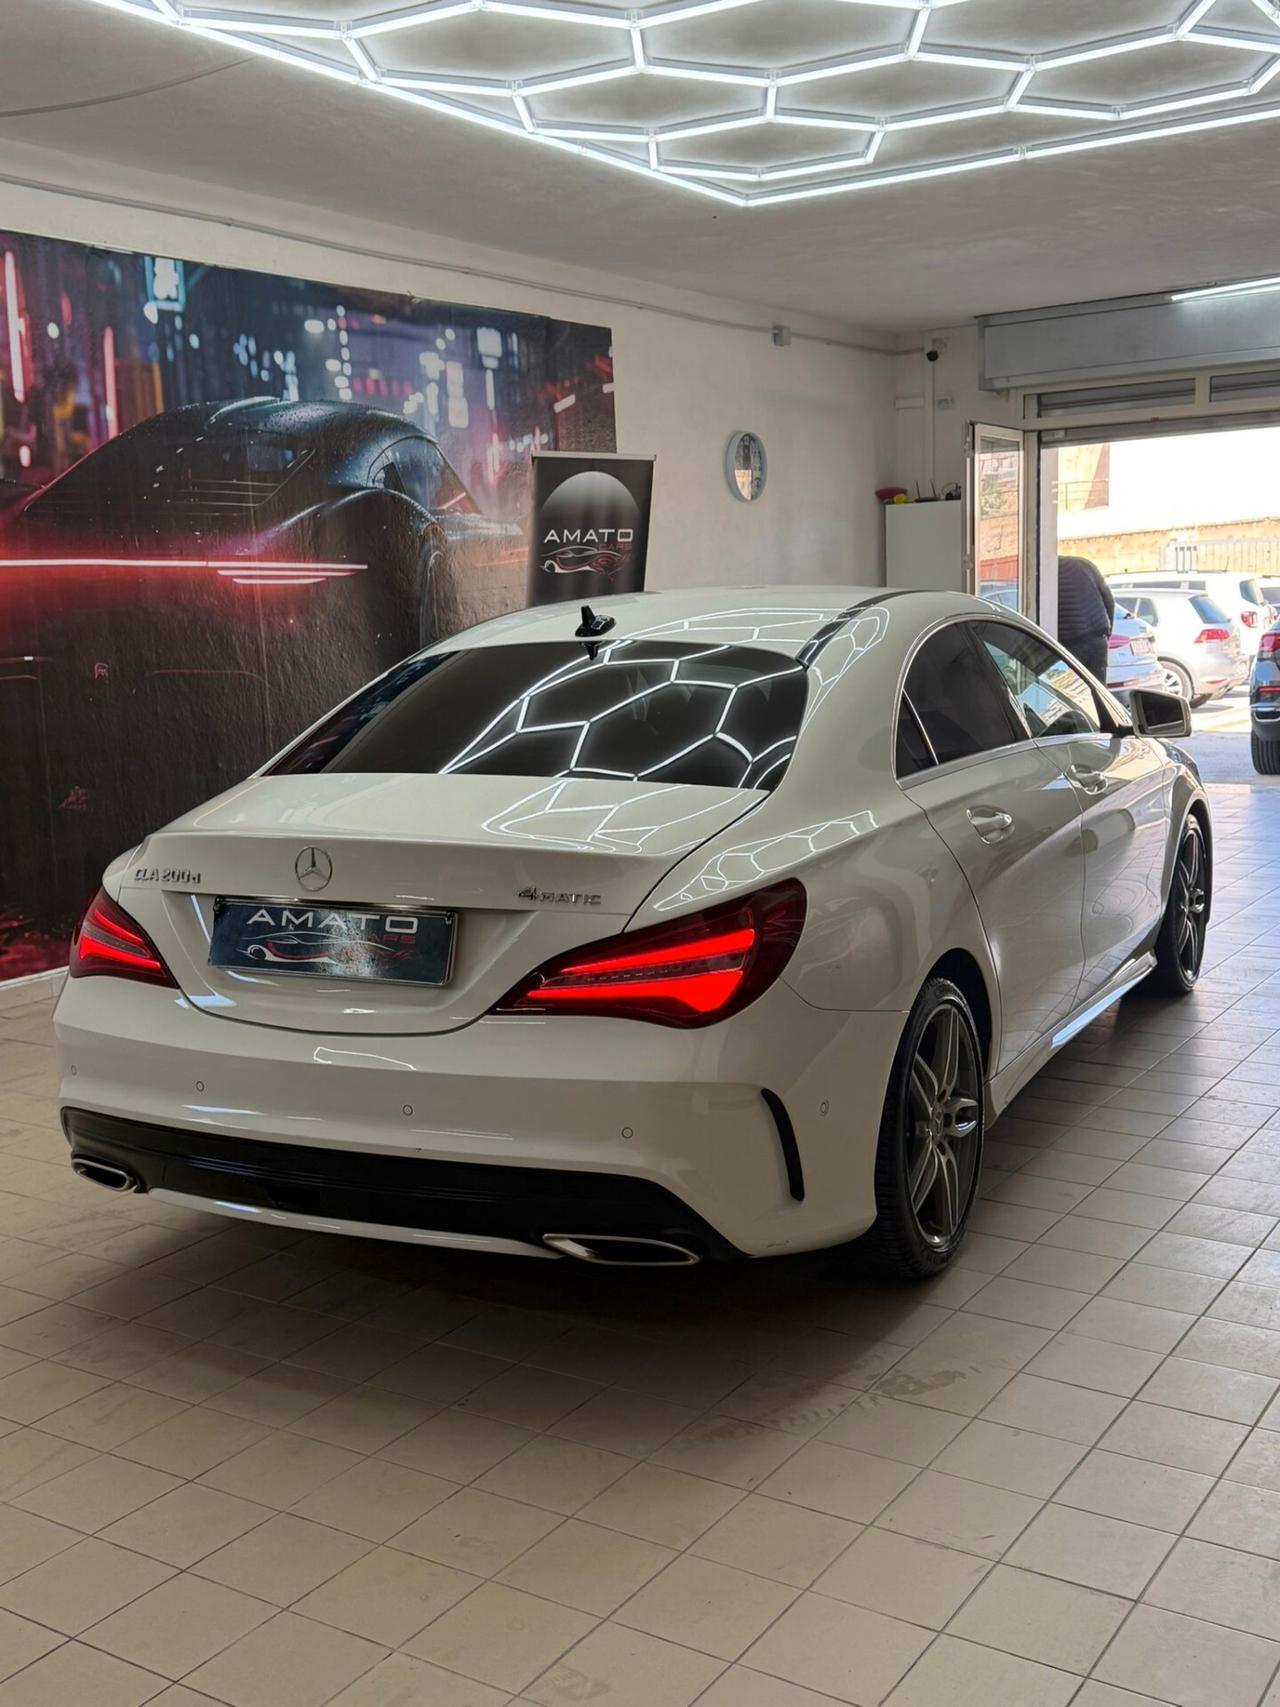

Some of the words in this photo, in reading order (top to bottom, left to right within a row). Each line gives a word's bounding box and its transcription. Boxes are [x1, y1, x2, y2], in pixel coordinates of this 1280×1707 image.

[543, 528, 633, 543] AMATO
[598, 543, 632, 551] CARS
[135, 868, 159, 881] CLA
[246, 908, 418, 934] AMATO
